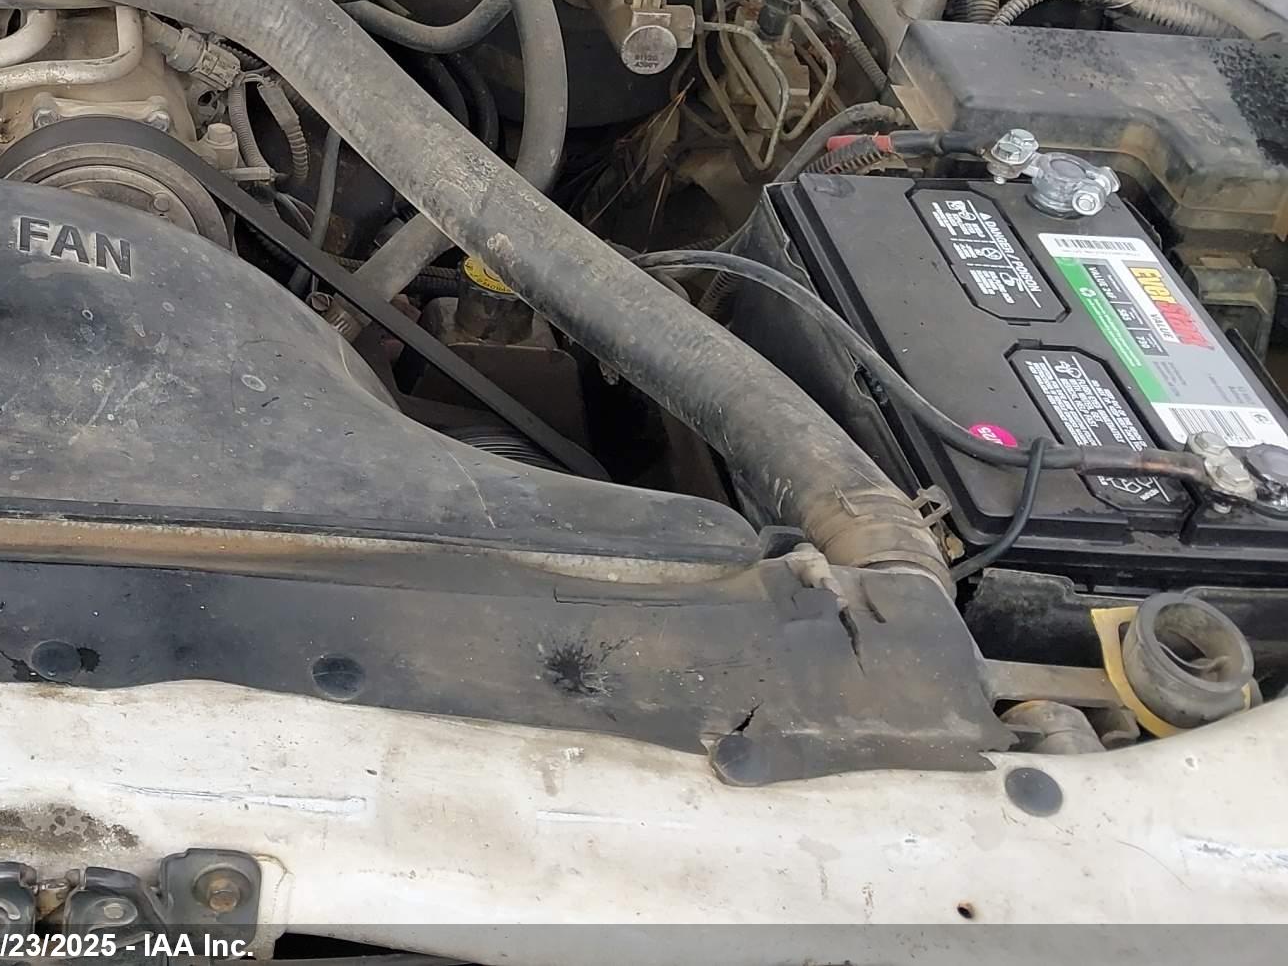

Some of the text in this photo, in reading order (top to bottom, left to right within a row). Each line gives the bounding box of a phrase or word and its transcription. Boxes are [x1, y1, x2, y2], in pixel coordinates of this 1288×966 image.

[18, 215, 134, 278] FAN
[984, 221, 1015, 254] DANGER
[1011, 261, 1042, 292] POISON
[1151, 314, 1175, 339] VALUE
